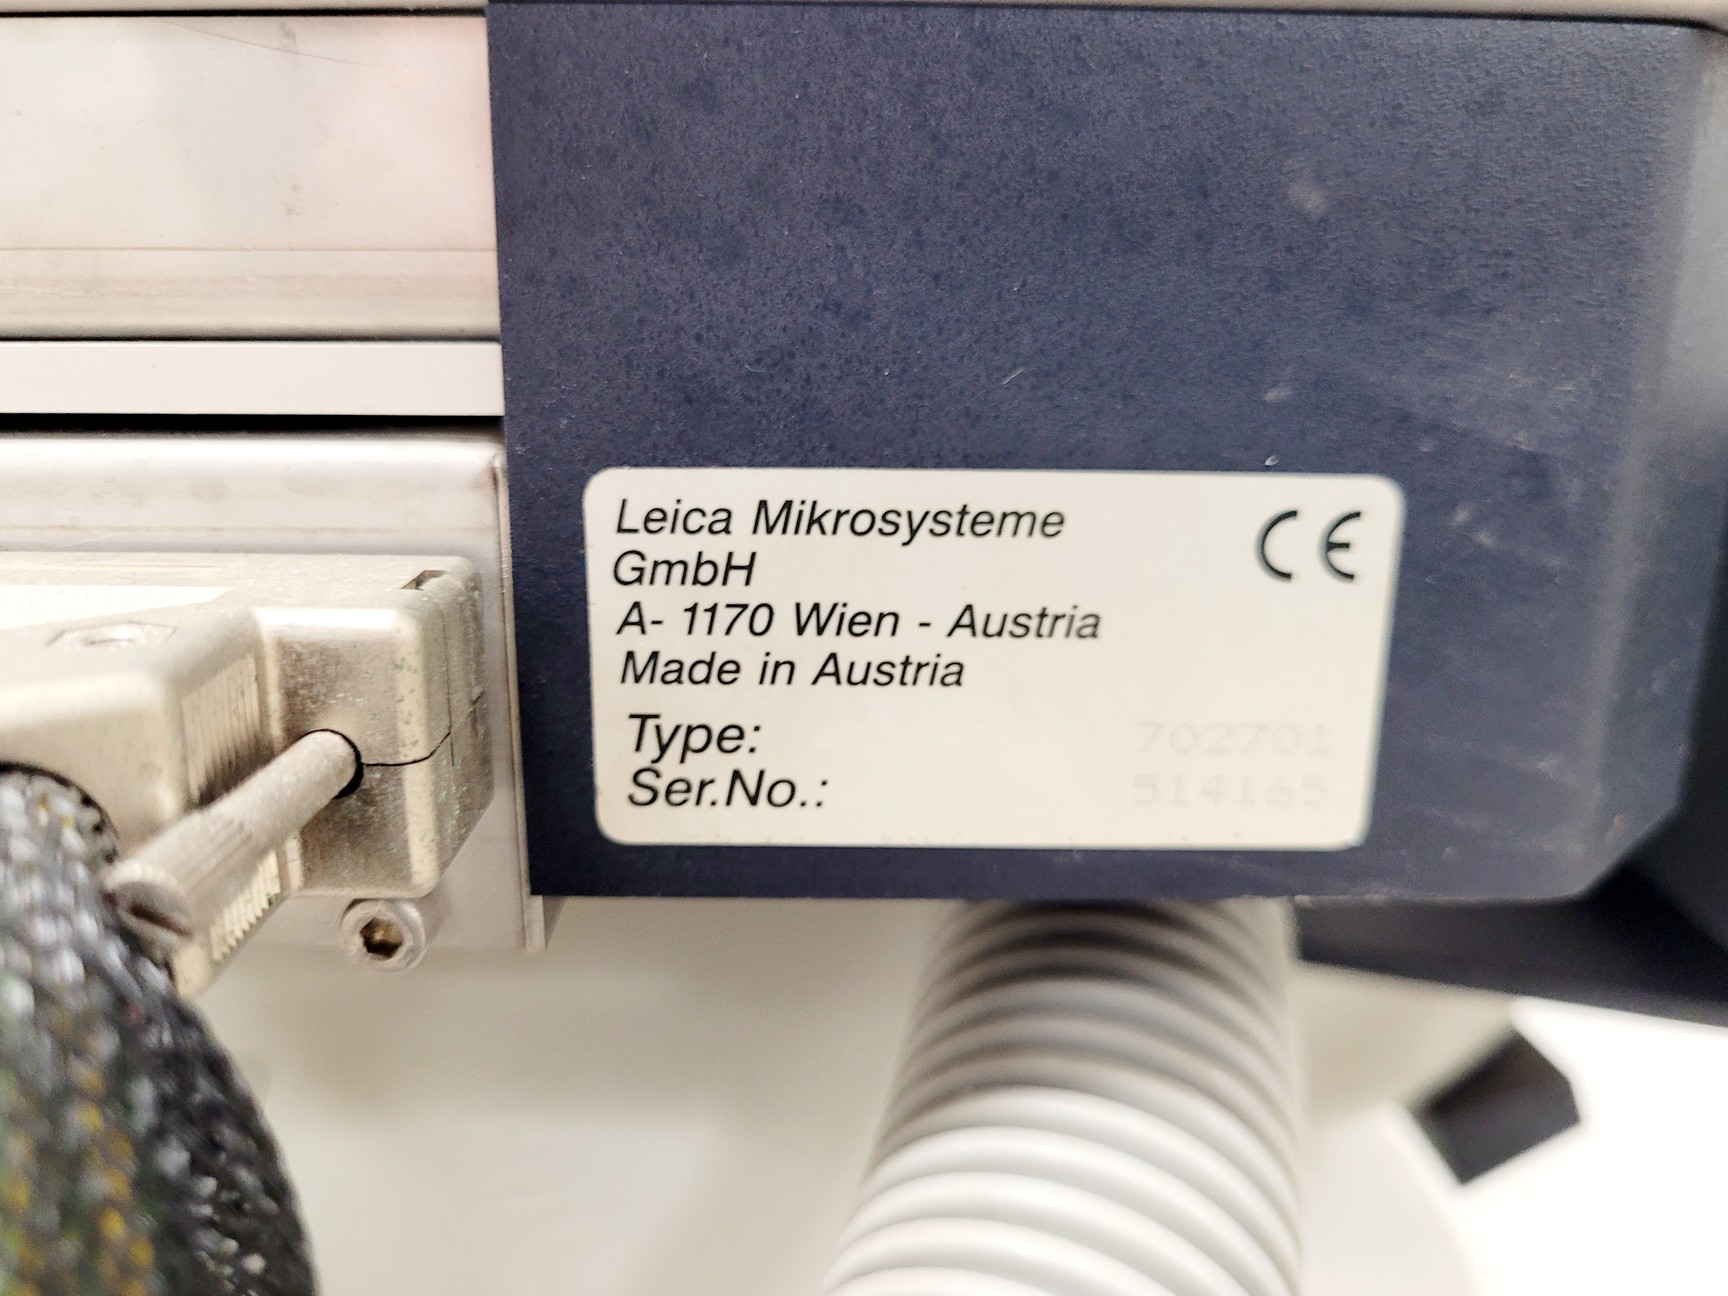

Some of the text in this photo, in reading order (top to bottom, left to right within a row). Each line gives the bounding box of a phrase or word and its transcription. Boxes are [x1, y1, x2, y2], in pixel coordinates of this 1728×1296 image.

[616, 498, 1066, 547] Leica Mikrosysteme
[1256, 508, 1363, 582] CE
[612, 549, 757, 588] GmbH
[683, 601, 775, 637] 1170
[794, 601, 900, 638] Wien
[946, 602, 1101, 640] Austria
[620, 650, 965, 688] Made in Austria
[627, 713, 1331, 766] Type: 702701
[627, 765, 1327, 809] Ser.No.: 514165
